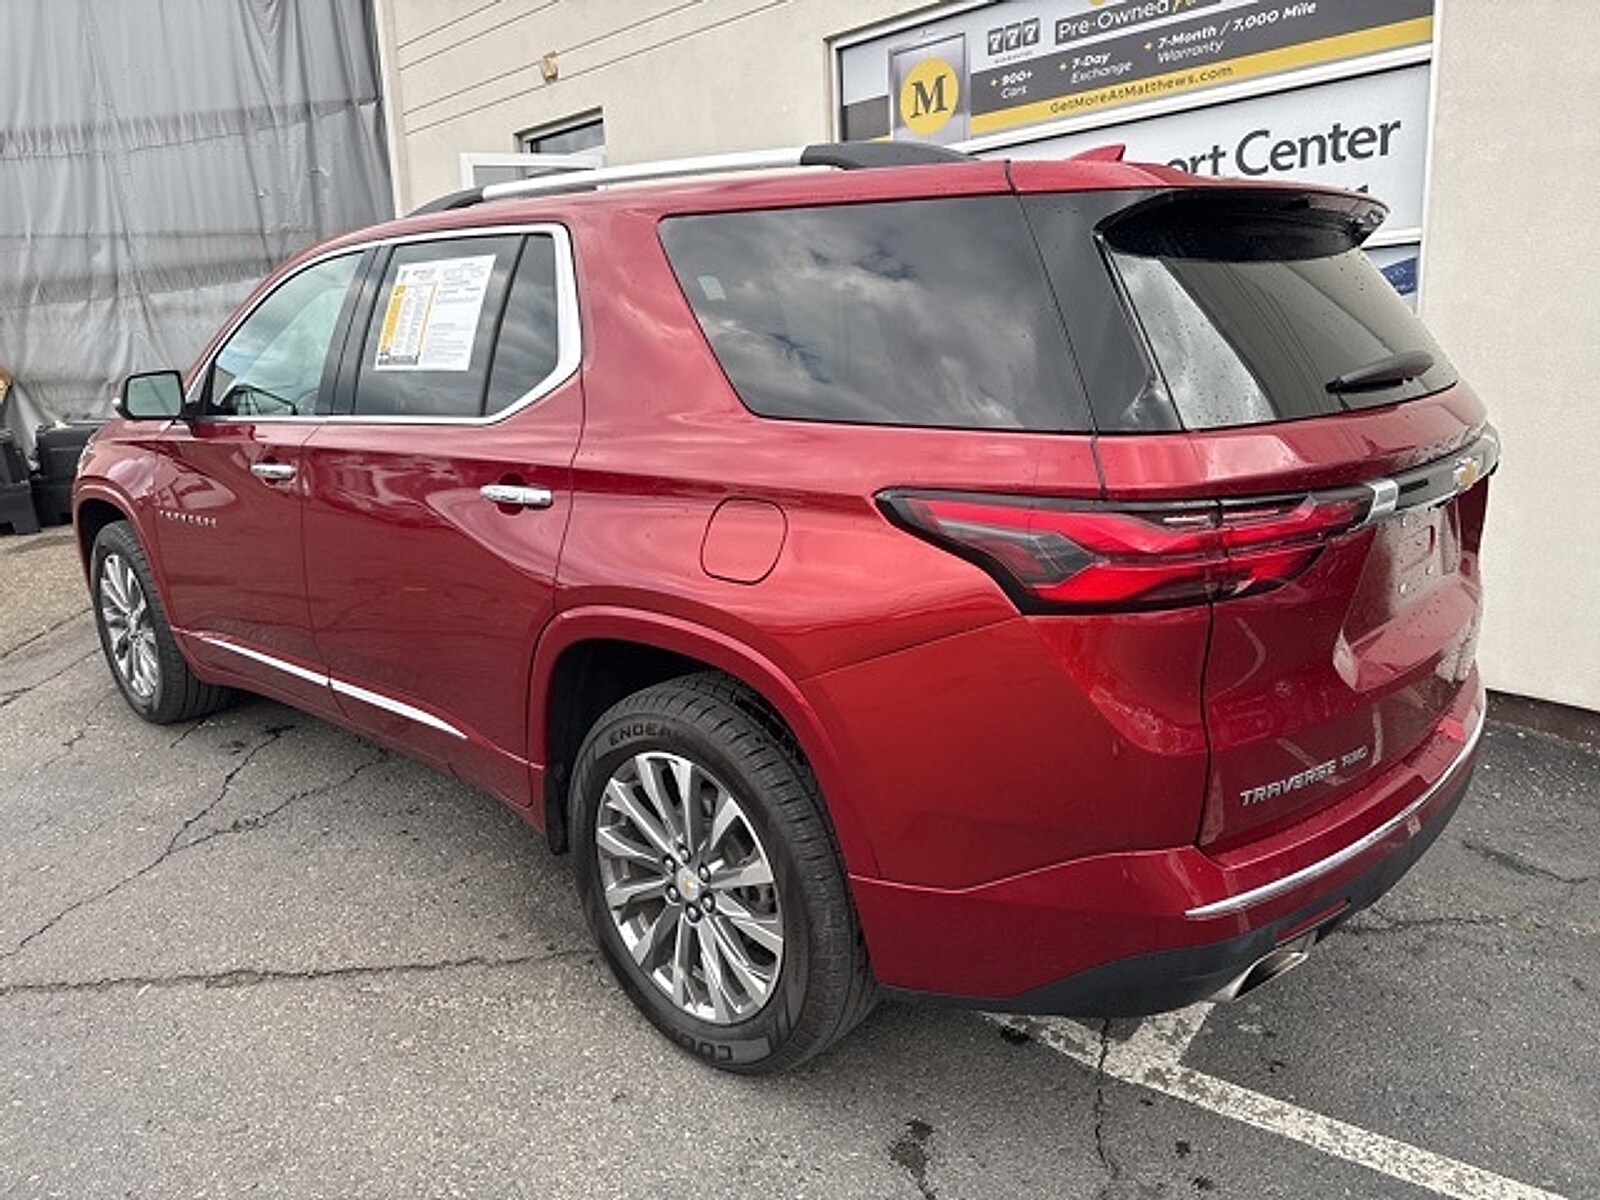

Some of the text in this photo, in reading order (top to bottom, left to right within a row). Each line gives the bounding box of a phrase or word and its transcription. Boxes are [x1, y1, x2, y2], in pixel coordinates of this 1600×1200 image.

[1058, 0, 1169, 38] Pre-Owned
[1157, 25, 1217, 49] 7-Month
[1233, 10, 1279, 31] 7,000
[1282, 2, 1318, 19] Mile
[1072, 53, 1112, 69] 7-Day
[1157, 40, 1225, 64] Warranty
[1070, 61, 1134, 84] Exchange
[910, 74, 949, 119] M
[1000, 85, 1028, 99] Cars
[1167, 120, 1401, 176] ort Center
[1240, 759, 1336, 806] TRAVERSE
